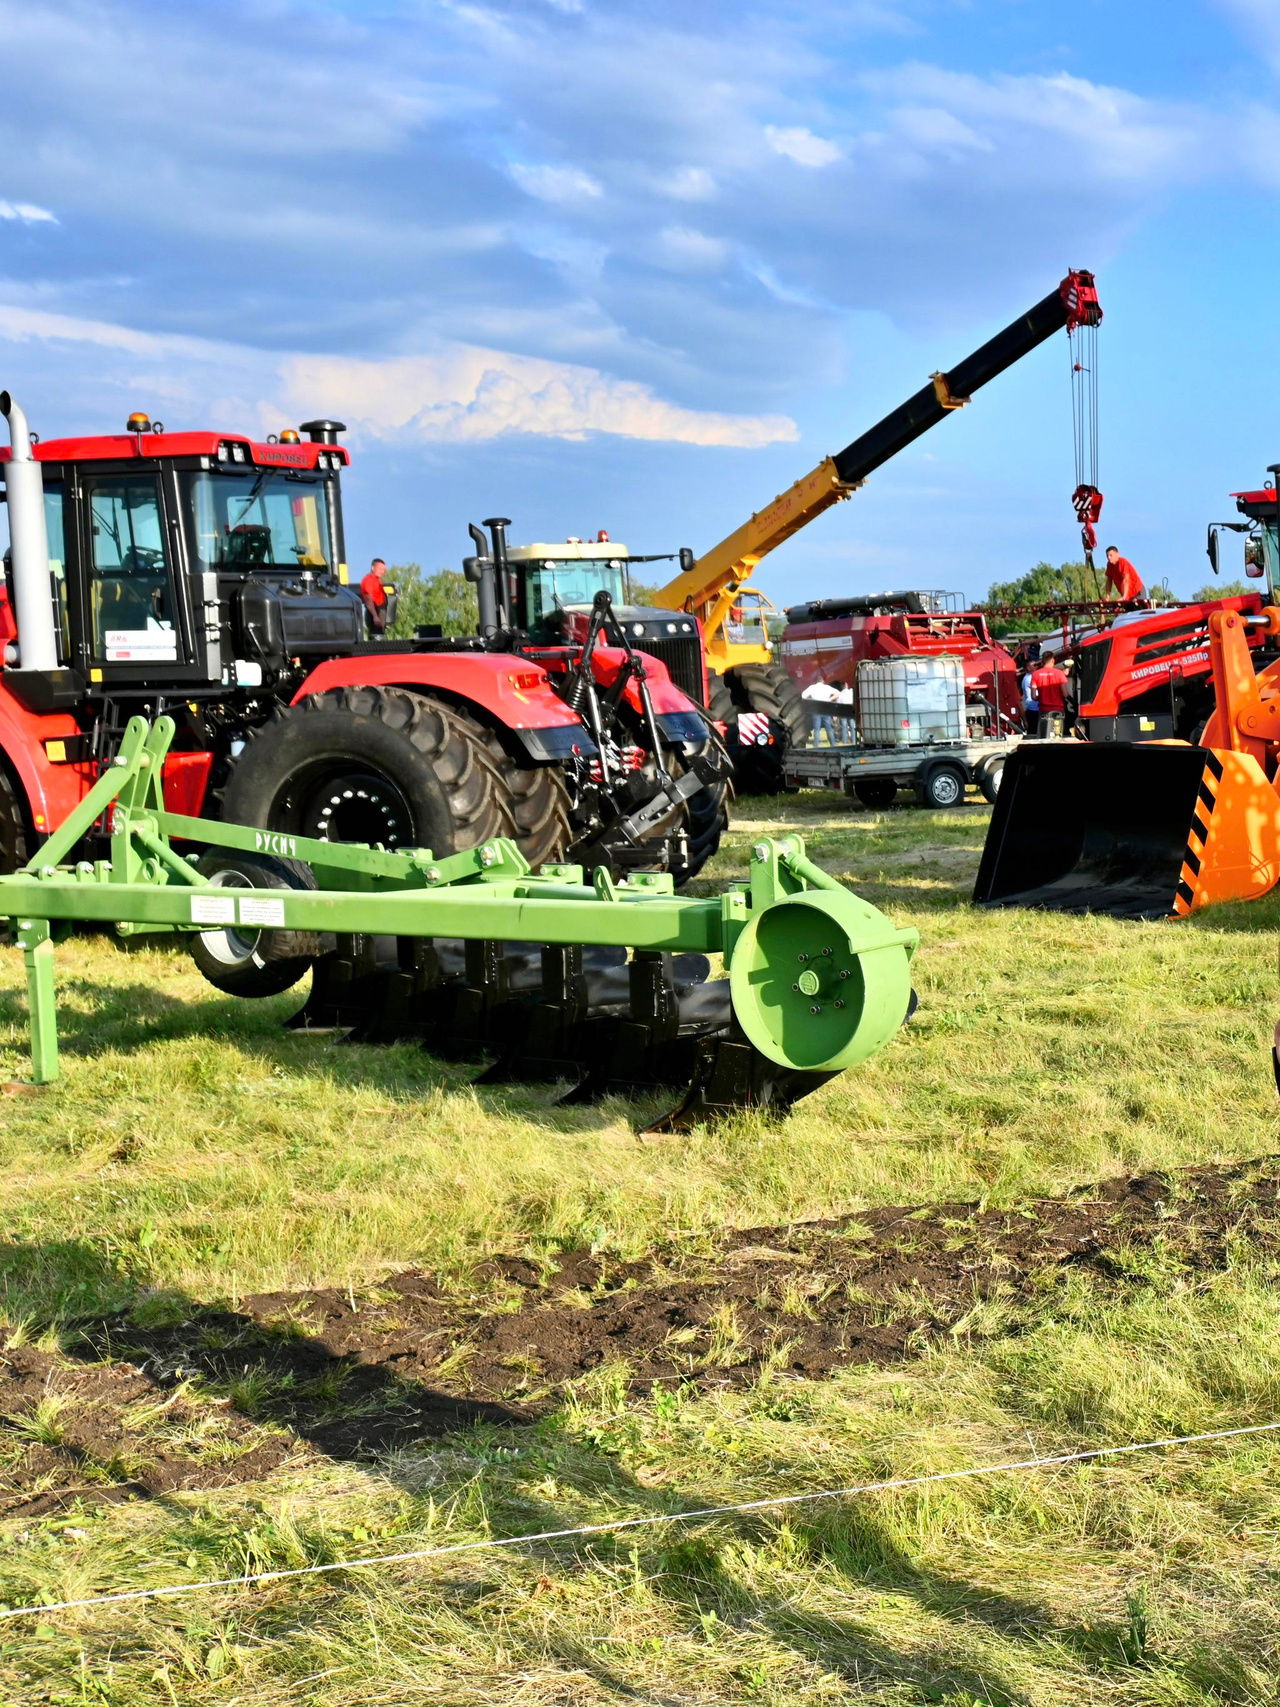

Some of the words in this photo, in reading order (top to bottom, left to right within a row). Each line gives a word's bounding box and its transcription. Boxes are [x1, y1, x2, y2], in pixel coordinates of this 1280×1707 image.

[259, 451, 309, 465] КИРОВЕЦ
[1131, 661, 1173, 680] КИРОВЕЦ
[255, 832, 296, 857] РУСИЧ
